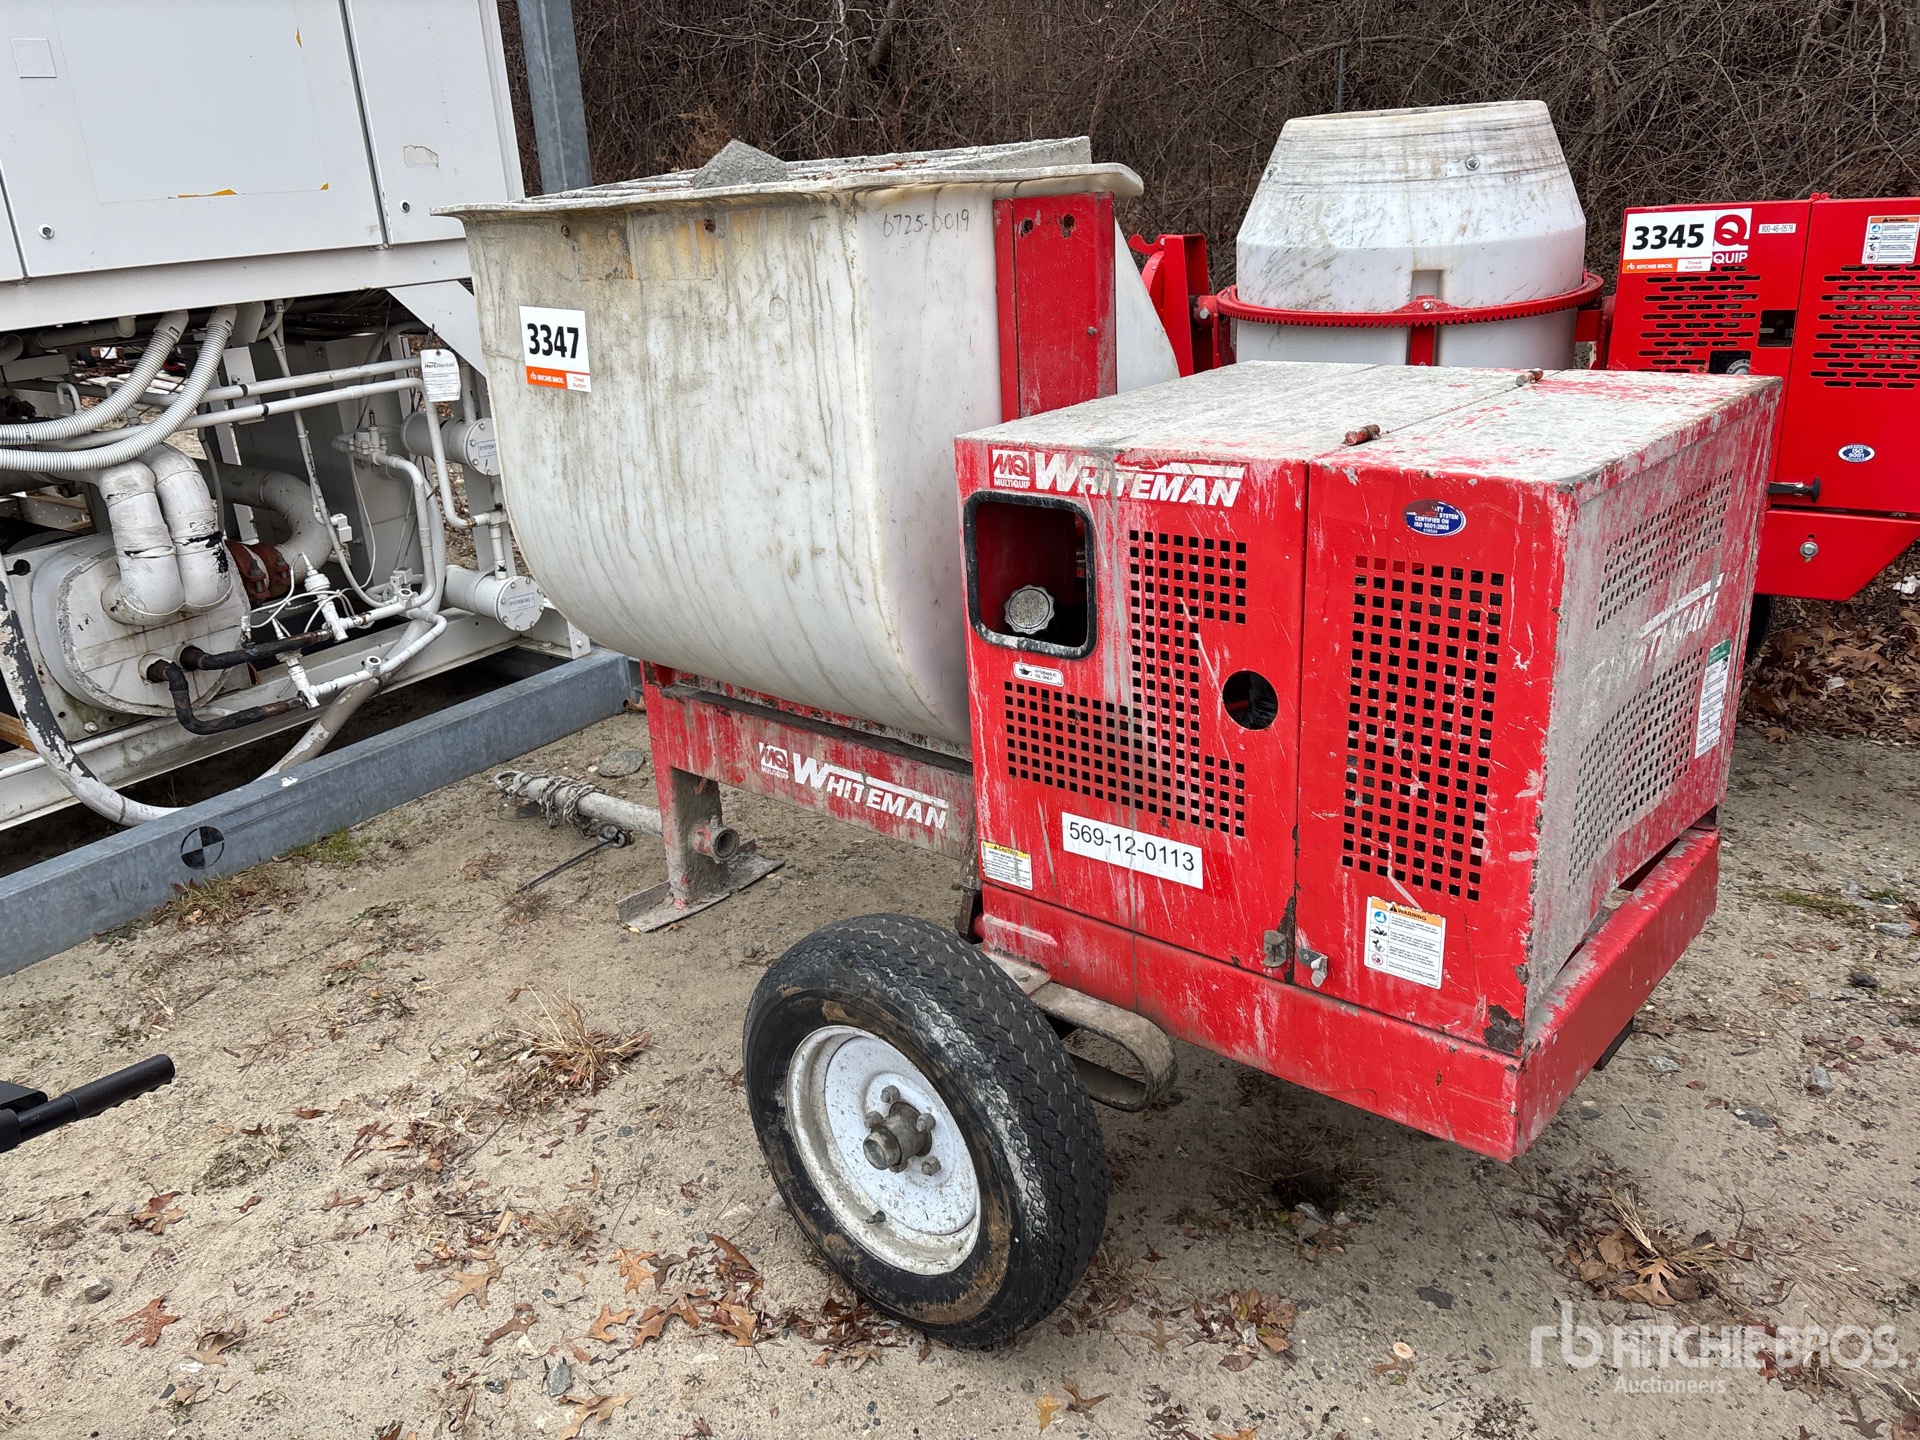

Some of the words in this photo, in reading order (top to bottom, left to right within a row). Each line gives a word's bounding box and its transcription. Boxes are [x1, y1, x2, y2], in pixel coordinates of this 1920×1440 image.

[1632, 223, 1705, 251] 3345
[1712, 252, 1748, 265] QUIP
[527, 322, 580, 359] 3347
[994, 477, 1031, 489] MULTIQUIP
[1069, 821, 1195, 872] 569-12-0113
[1397, 909, 1427, 920] WARNING
